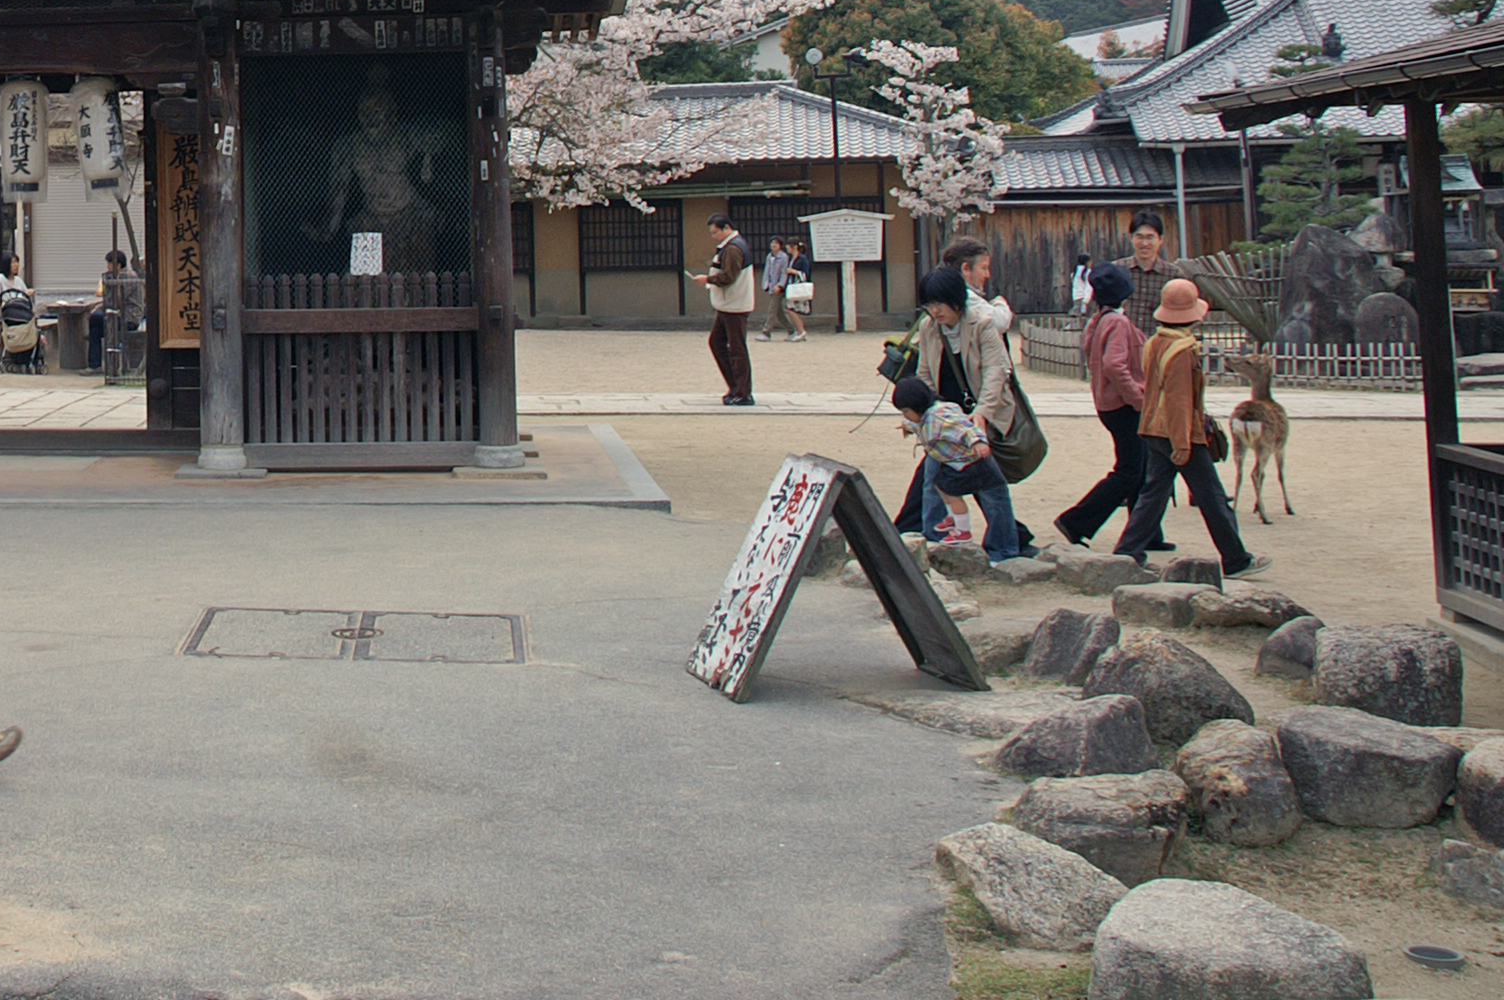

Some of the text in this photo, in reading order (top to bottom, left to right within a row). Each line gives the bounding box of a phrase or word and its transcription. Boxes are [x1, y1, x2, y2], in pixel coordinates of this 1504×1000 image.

[7, 92, 31, 175] 厳島弁財天
[78, 105, 94, 159] 大願寺
